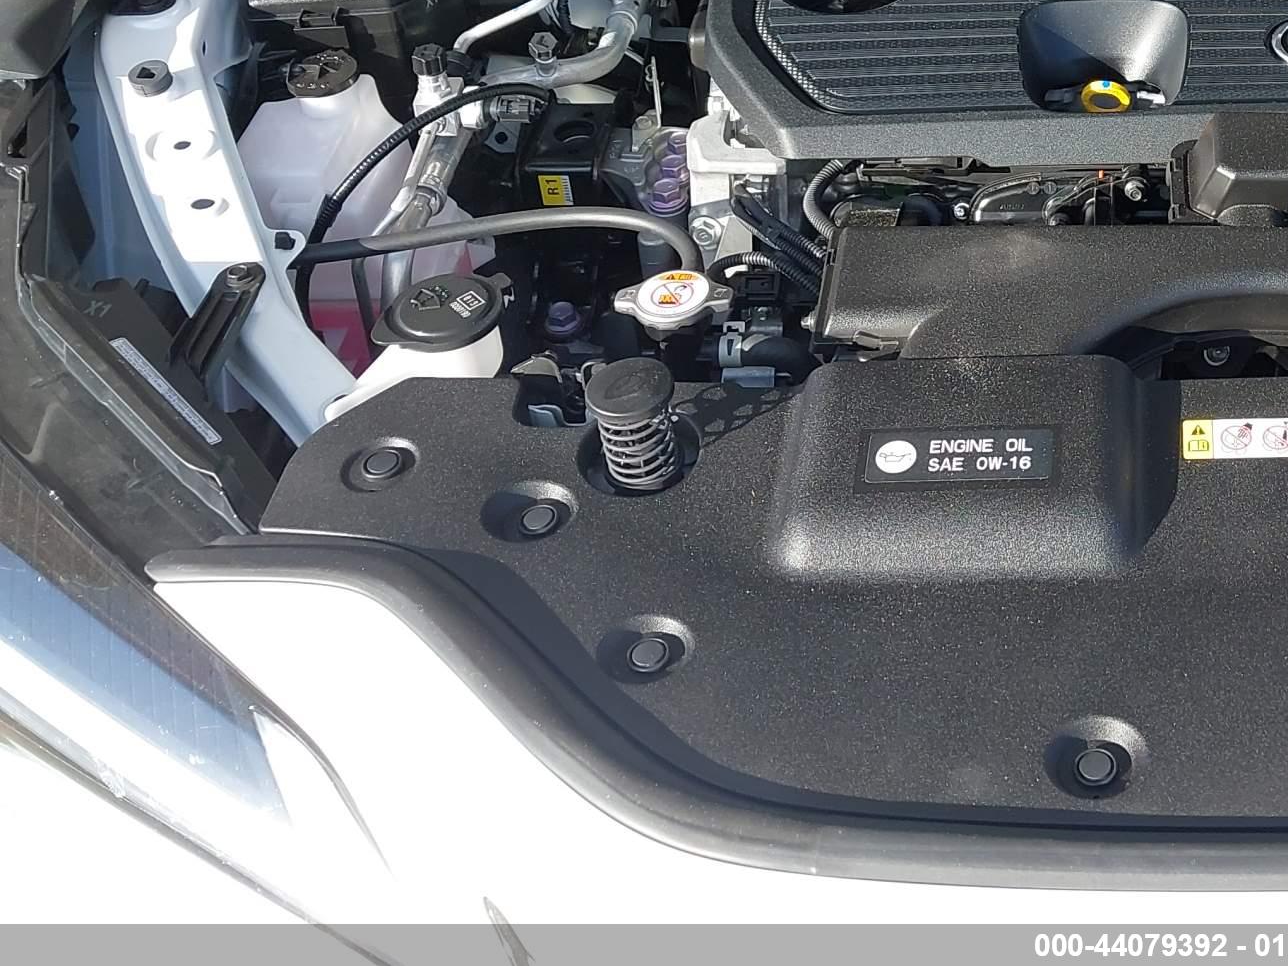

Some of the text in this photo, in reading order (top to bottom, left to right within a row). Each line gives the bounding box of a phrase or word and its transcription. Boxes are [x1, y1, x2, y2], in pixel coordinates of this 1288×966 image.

[929, 438, 1033, 455] ENGINE OIL
[927, 455, 1032, 472] SAE 0W-16
